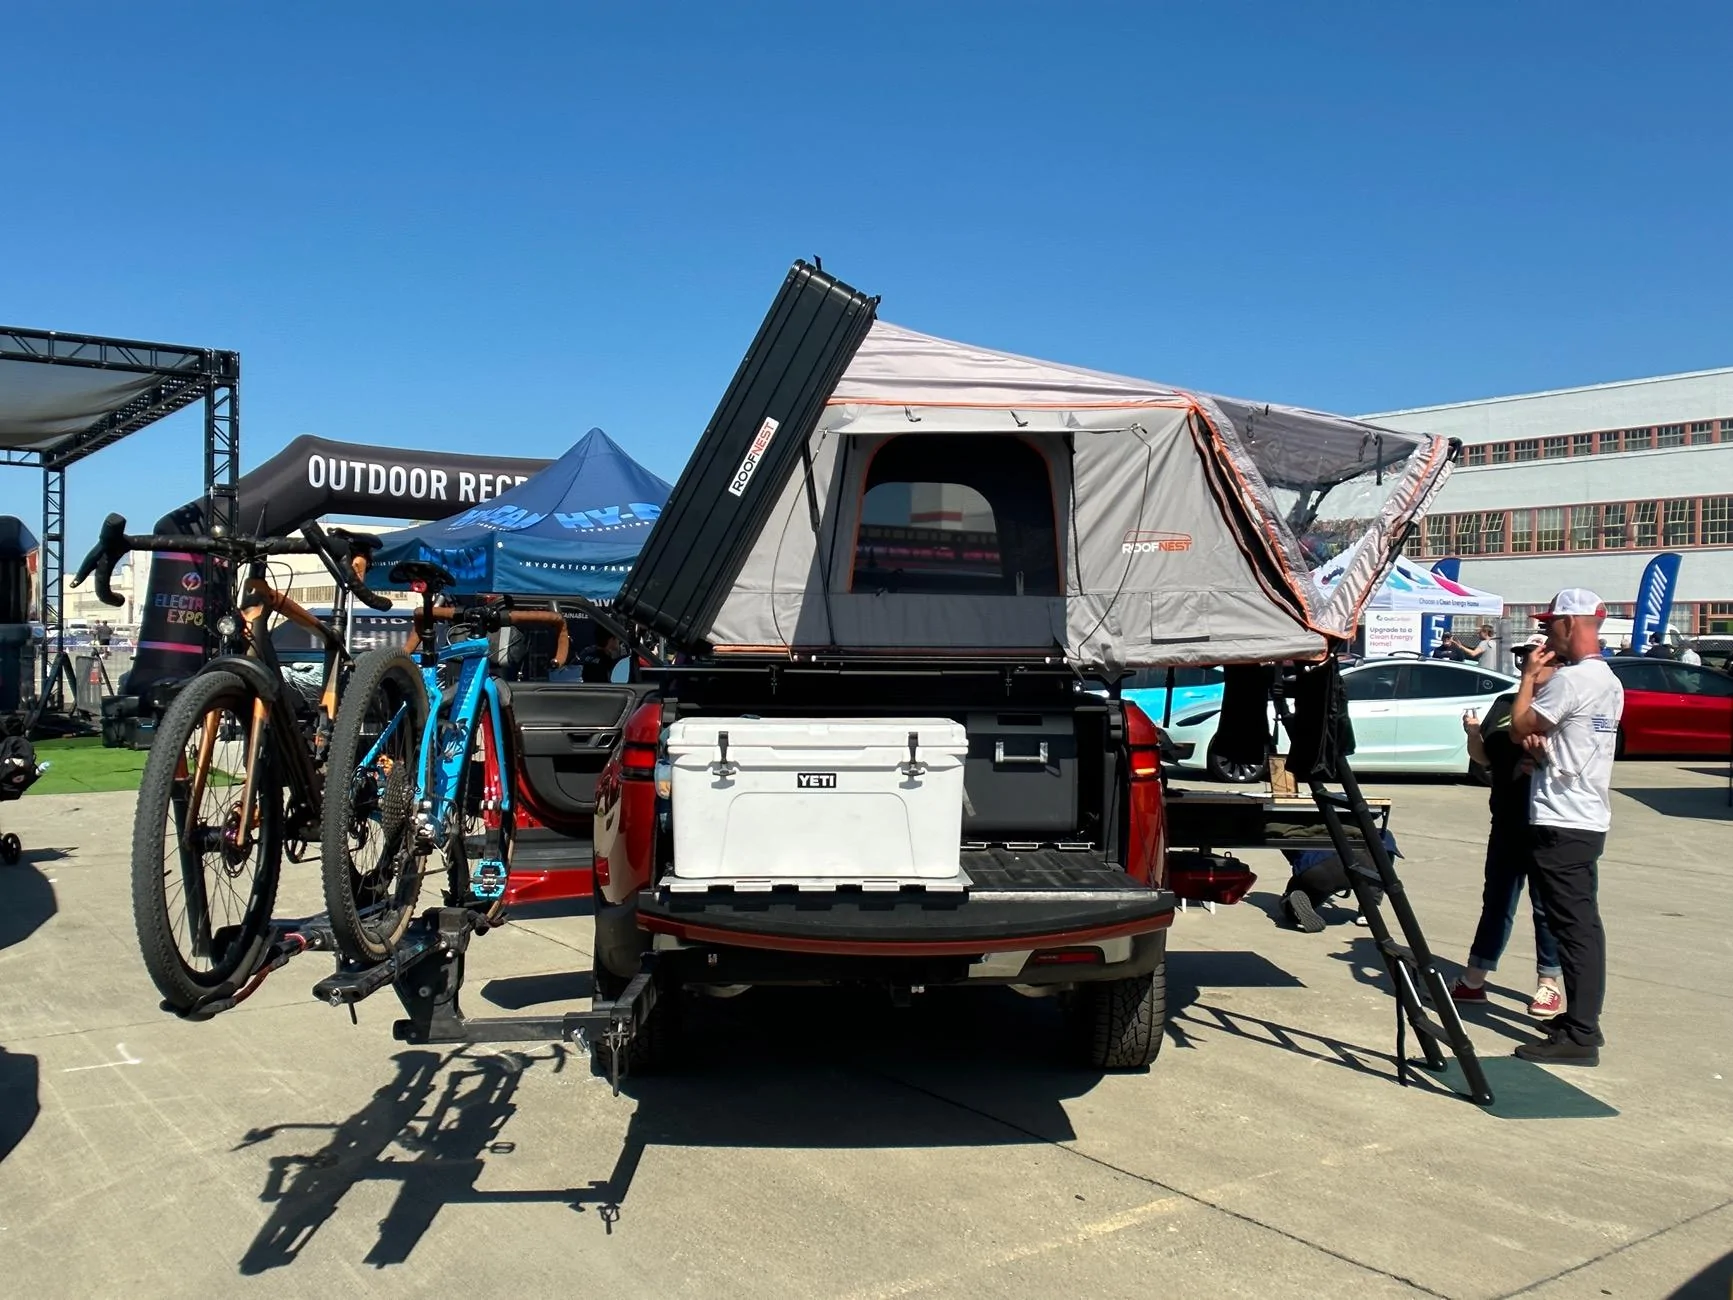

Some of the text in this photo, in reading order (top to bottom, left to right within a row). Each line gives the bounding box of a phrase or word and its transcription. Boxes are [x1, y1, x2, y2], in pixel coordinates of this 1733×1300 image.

[732, 422, 774, 492] ROOFNEST
[308, 454, 448, 500] OUTDOOR
[1122, 541, 1192, 554] ROOFNEST
[526, 561, 596, 572] HYDRATION
[154, 593, 204, 611] ELECTR
[167, 609, 203, 626] EXPO
[1370, 627, 1398, 635] Upgrade
[799, 775, 834, 787] YETI
